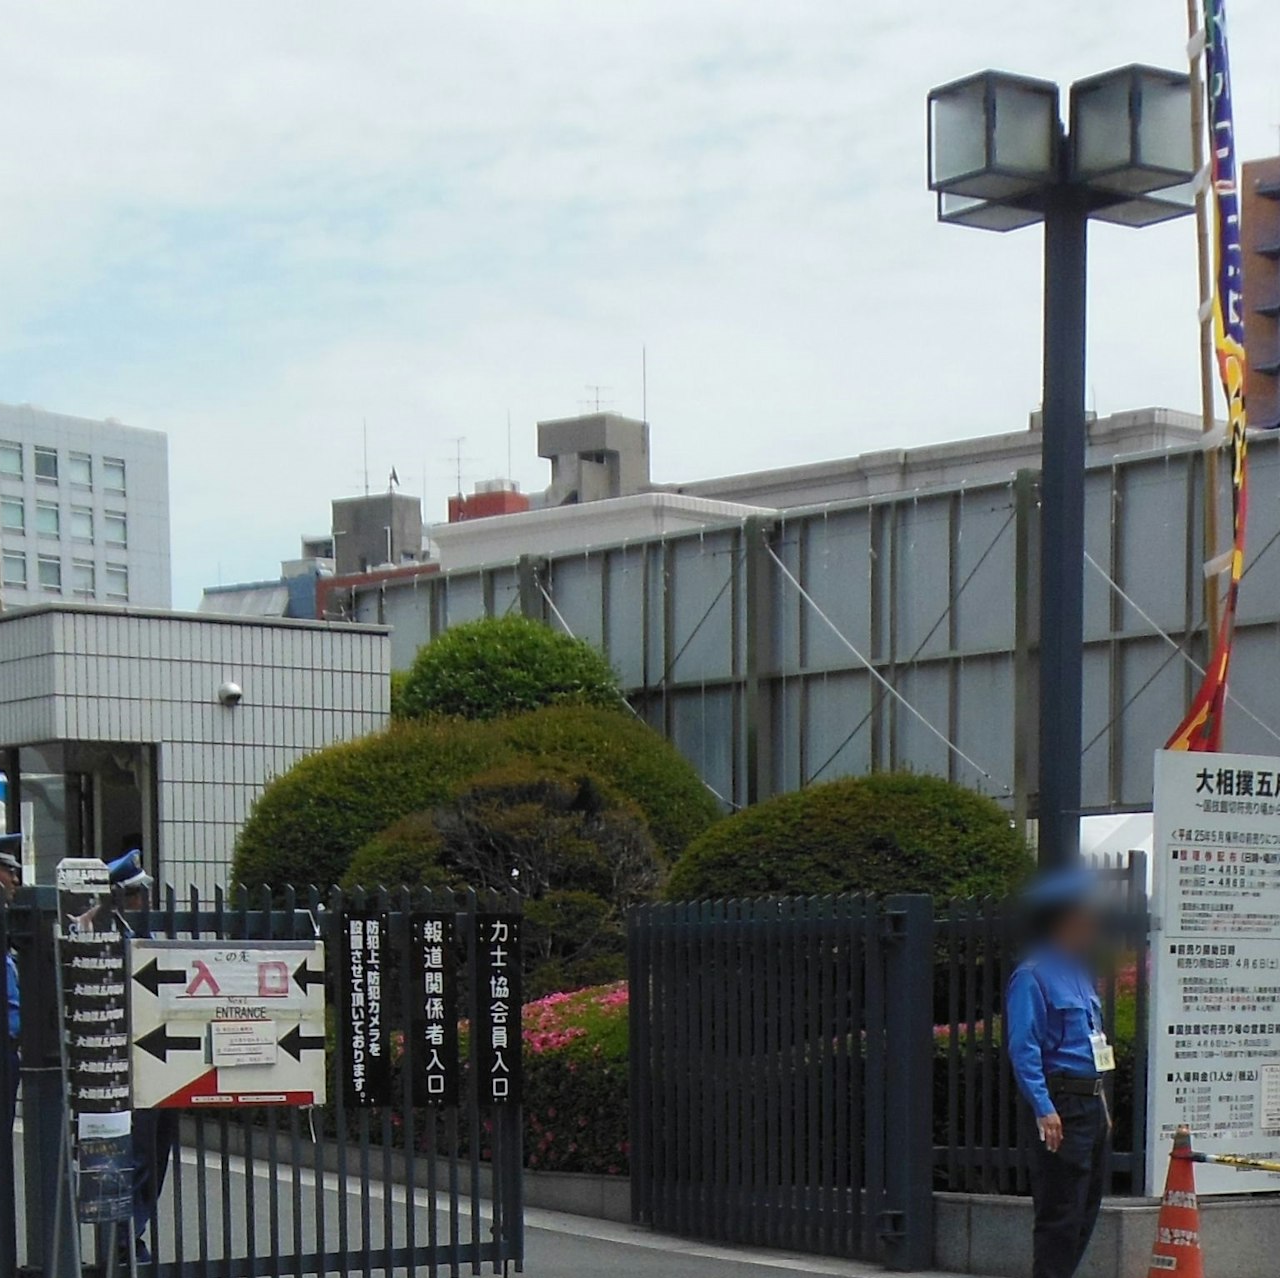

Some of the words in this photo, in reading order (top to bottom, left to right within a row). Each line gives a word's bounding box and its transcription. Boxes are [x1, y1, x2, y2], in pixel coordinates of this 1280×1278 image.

[185, 960, 289, 997] 入口
[214, 951, 251, 963] この先
[215, 1007, 267, 1019] ENTRANCE
[350, 920, 366, 1099] 設置させて頂いております。
[366, 920, 380, 1057] 防犯上、防犯カメラを
[423, 920, 446, 1093] 報道関係者入口
[490, 920, 510, 1097] 力士・協会員入口
